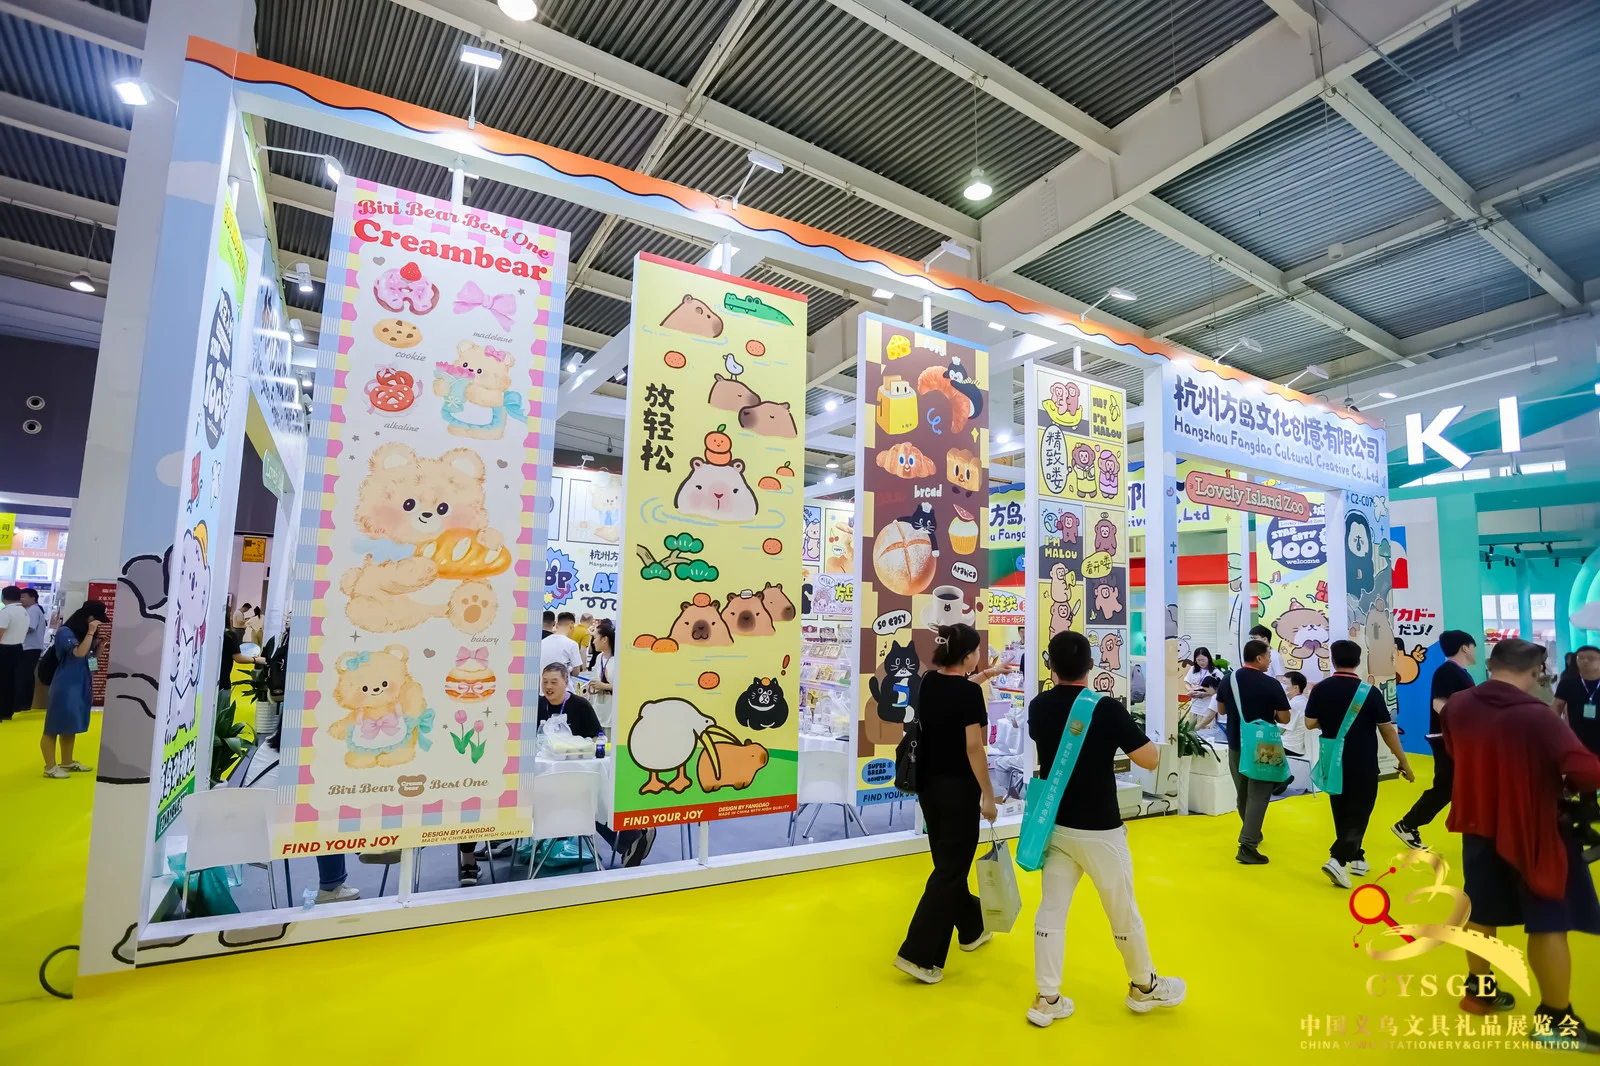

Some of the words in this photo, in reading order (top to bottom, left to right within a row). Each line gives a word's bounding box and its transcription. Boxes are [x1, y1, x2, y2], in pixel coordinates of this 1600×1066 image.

[358, 199, 402, 216] Biri
[405, 201, 460, 223] Bear
[462, 212, 511, 239] Best
[512, 232, 550, 260] One
[354, 219, 548, 281] Creambear
[472, 330, 514, 344] madeleine
[395, 350, 427, 362] cookie
[384, 421, 420, 433] alkaline
[1173, 374, 1380, 465] 杭州方岛文化创意有限公司
[640, 383, 675, 473] 放轻松
[1093, 424, 1122, 439] MALOU
[1174, 415, 1228, 446] Hangzhou
[1231, 430, 1272, 459] Fangdao
[1274, 443, 1314, 466] Cultural
[1316, 454, 1350, 477] Creative
[914, 484, 943, 498] bread
[1195, 477, 1245, 505] Lovely
[1246, 488, 1282, 510] Island
[1283, 496, 1304, 515] Zoo
[1271, 527, 1297, 540] STAR
[1045, 547, 1078, 559] MALOU
[1270, 540, 1320, 560] 100
[888, 612, 907, 627] easy
[1398, 624, 1434, 636] だゾ!
[470, 633, 499, 645] bakery
[328, 784, 358, 796] Biri
[359, 782, 395, 794] Bear
[429, 779, 461, 790] Best
[462, 777, 489, 787] One
[863, 793, 882, 802] FIND
[623, 815, 650, 827] FIND
[652, 812, 681, 824] YOUR
[682, 809, 704, 821] JOY
[422, 830, 449, 838] DESIGN
[461, 826, 496, 835] FANGDAO
[282, 842, 321, 855] FIND
[325, 837, 367, 851] YOUR
[370, 835, 400, 849] JOY
